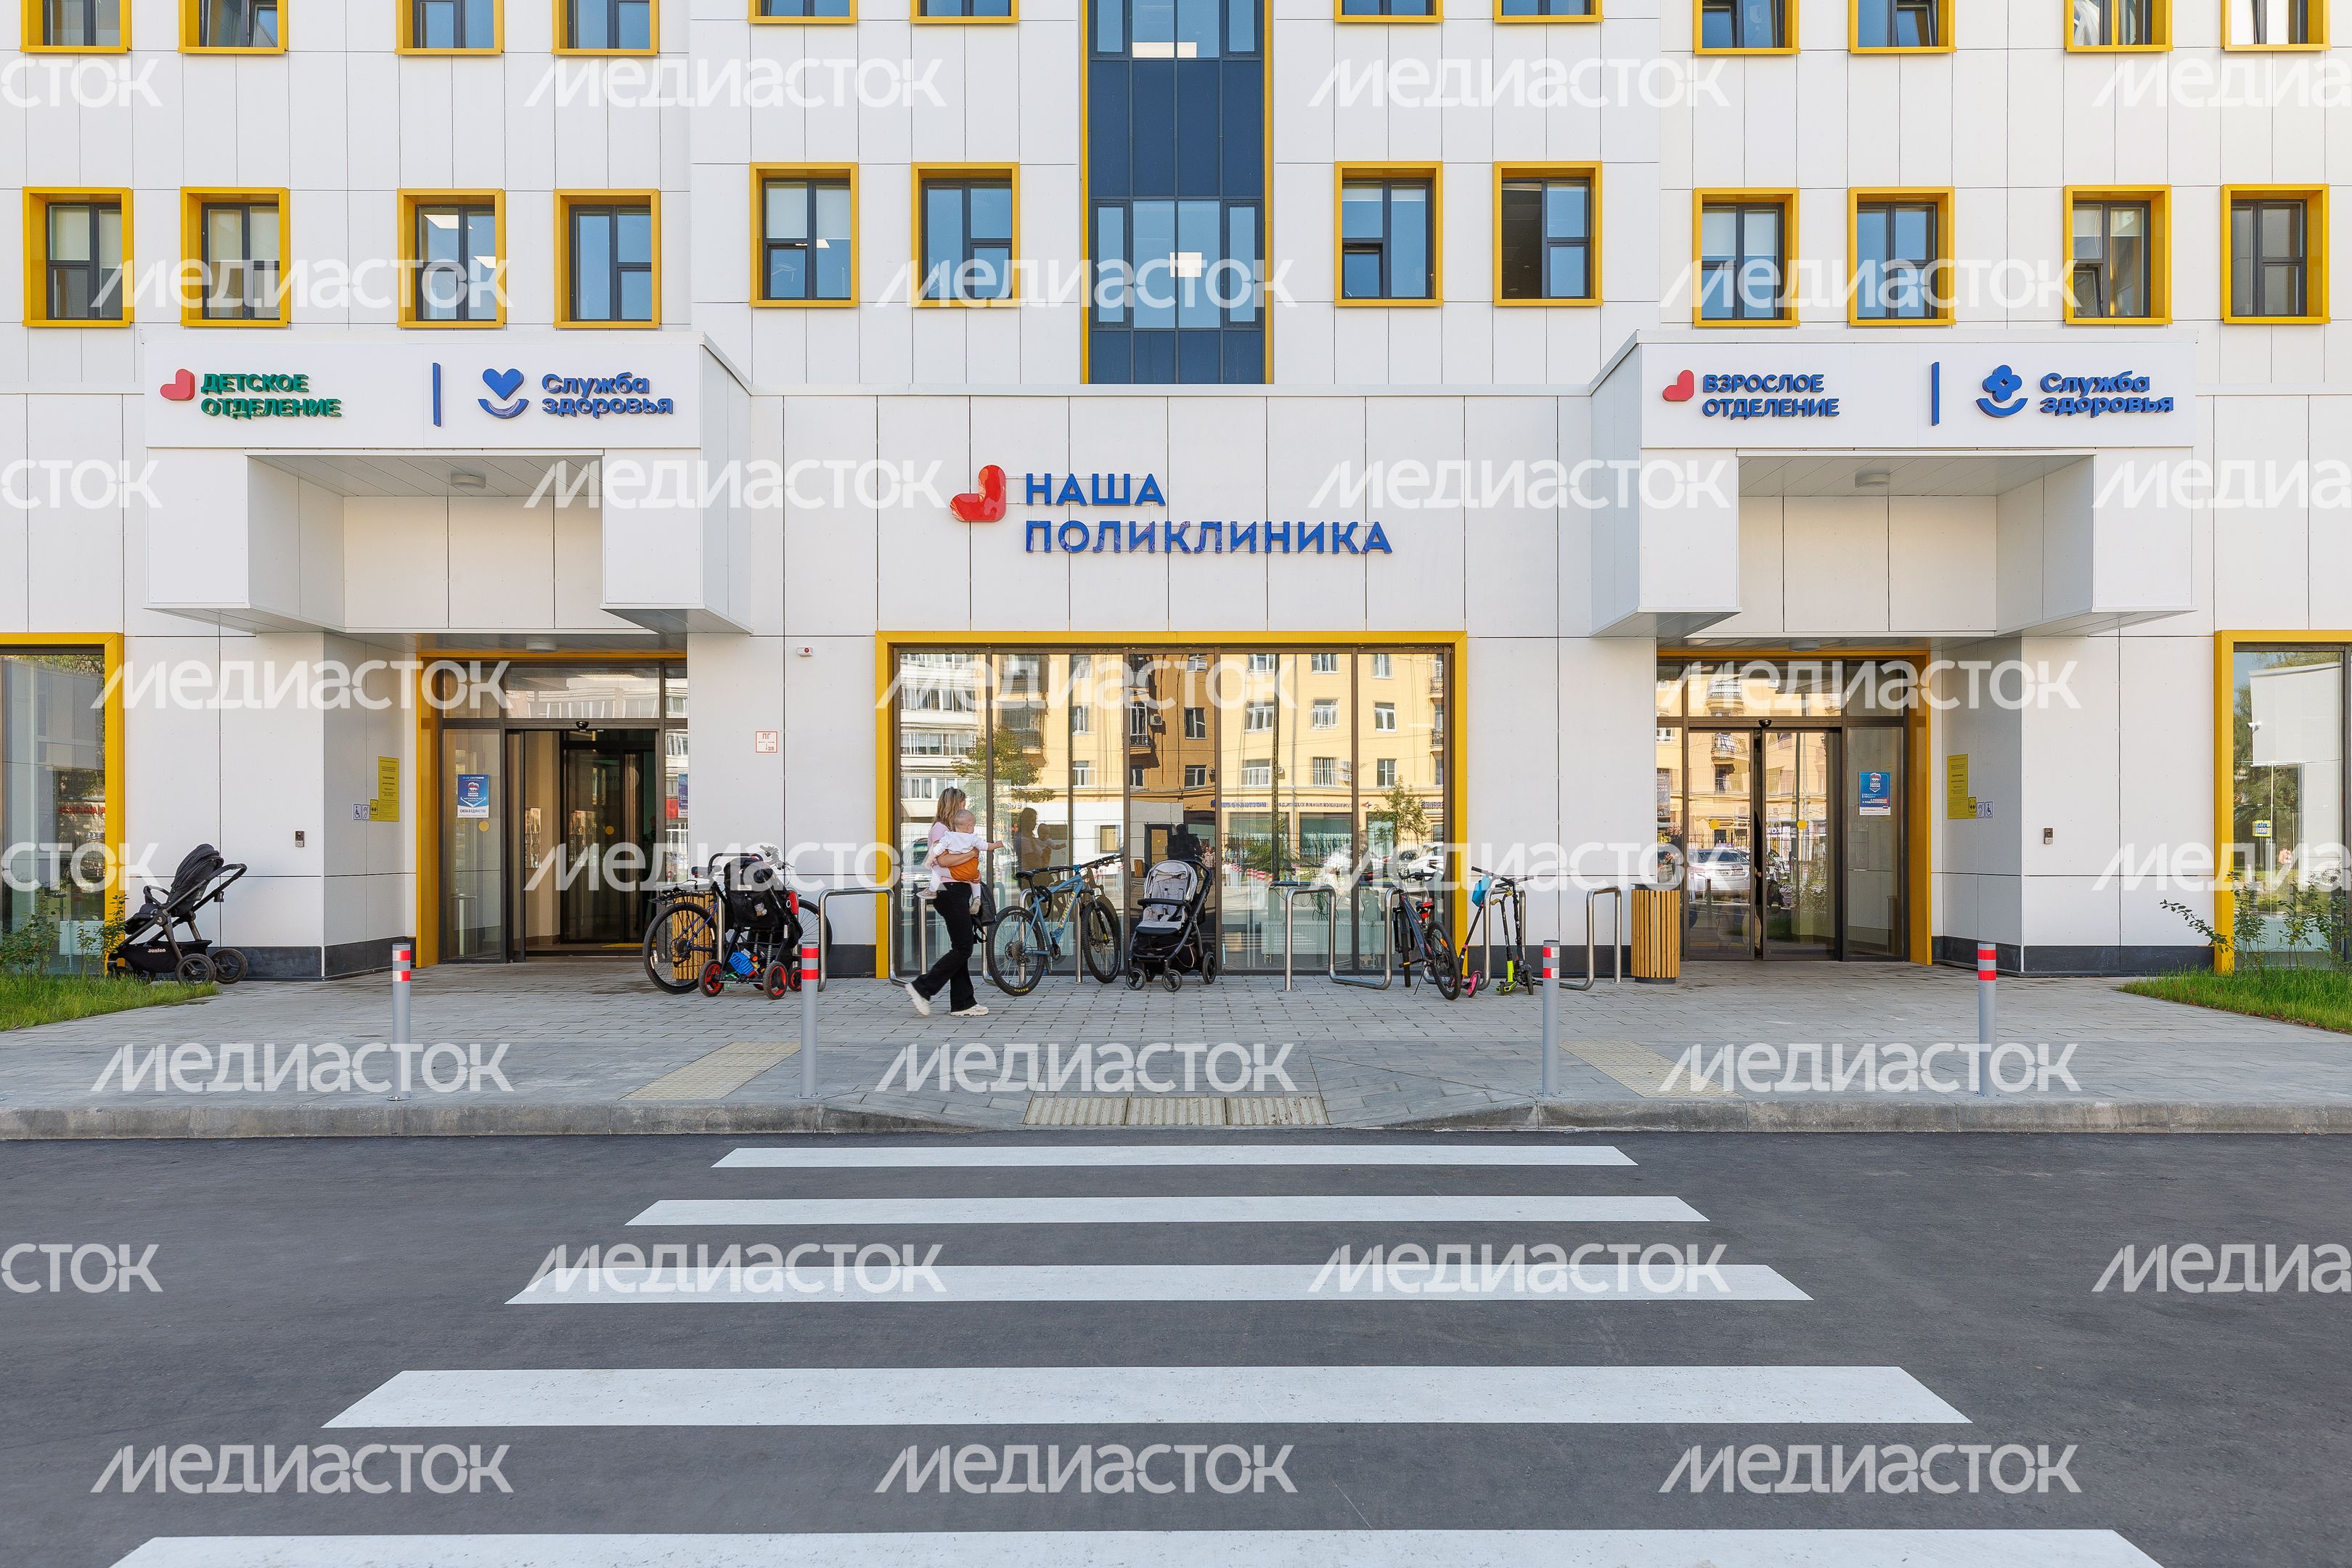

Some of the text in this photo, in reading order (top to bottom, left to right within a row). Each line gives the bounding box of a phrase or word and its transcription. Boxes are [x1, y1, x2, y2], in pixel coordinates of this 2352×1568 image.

[200, 373, 310, 393] ДЕТСКОЕ
[542, 372, 651, 396] Служба
[1702, 373, 1825, 393] ВЗРОСЛОЕ
[2040, 370, 2151, 395] Служба
[200, 398, 343, 420] ОТДЕЛЕНИЕ
[542, 396, 674, 418] здоровья
[1702, 398, 1840, 420] ОТДЕЛЕНИЕ
[2040, 395, 2174, 417] здоровья
[1026, 473, 1166, 507] НАША
[1026, 520, 1393, 555] ПОЛИКЛИНИКА
